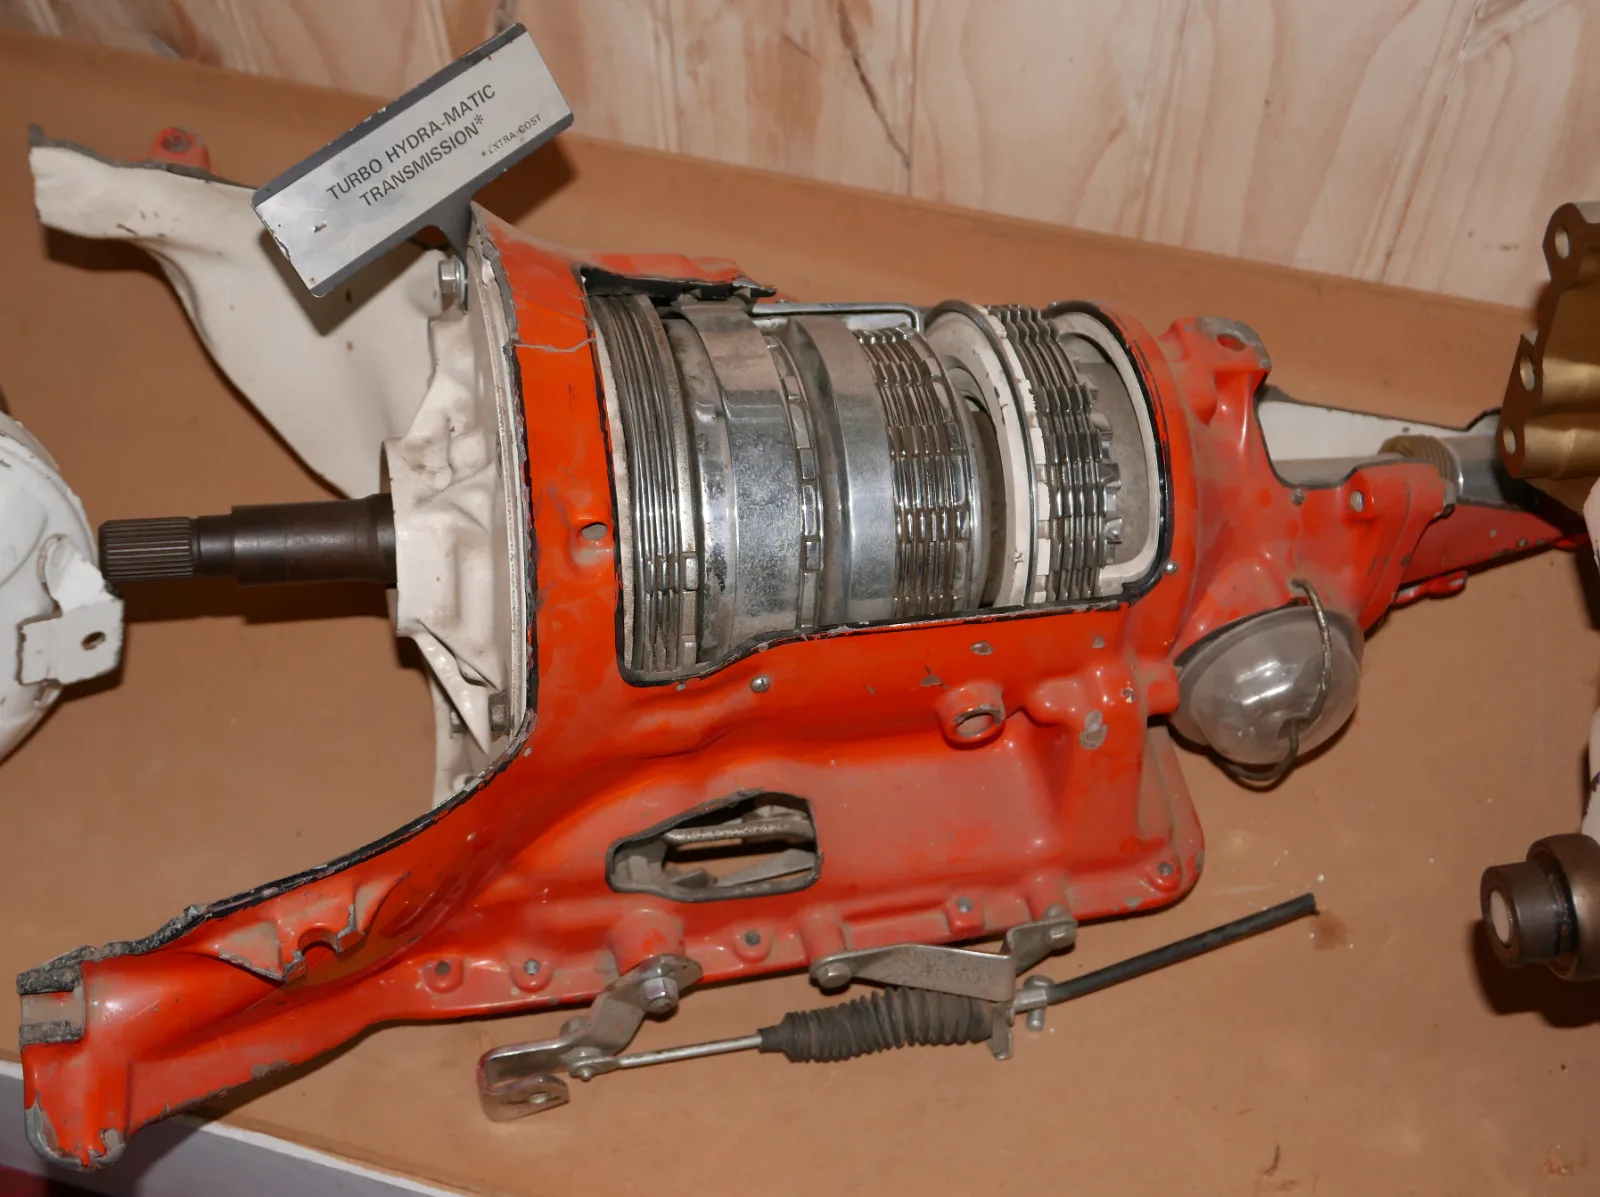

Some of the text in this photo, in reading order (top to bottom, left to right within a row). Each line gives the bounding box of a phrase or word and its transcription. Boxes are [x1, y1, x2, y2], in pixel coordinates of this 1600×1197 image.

[326, 84, 496, 200] TURBO HYDRA-MATIC
[518, 113, 541, 134] COST
